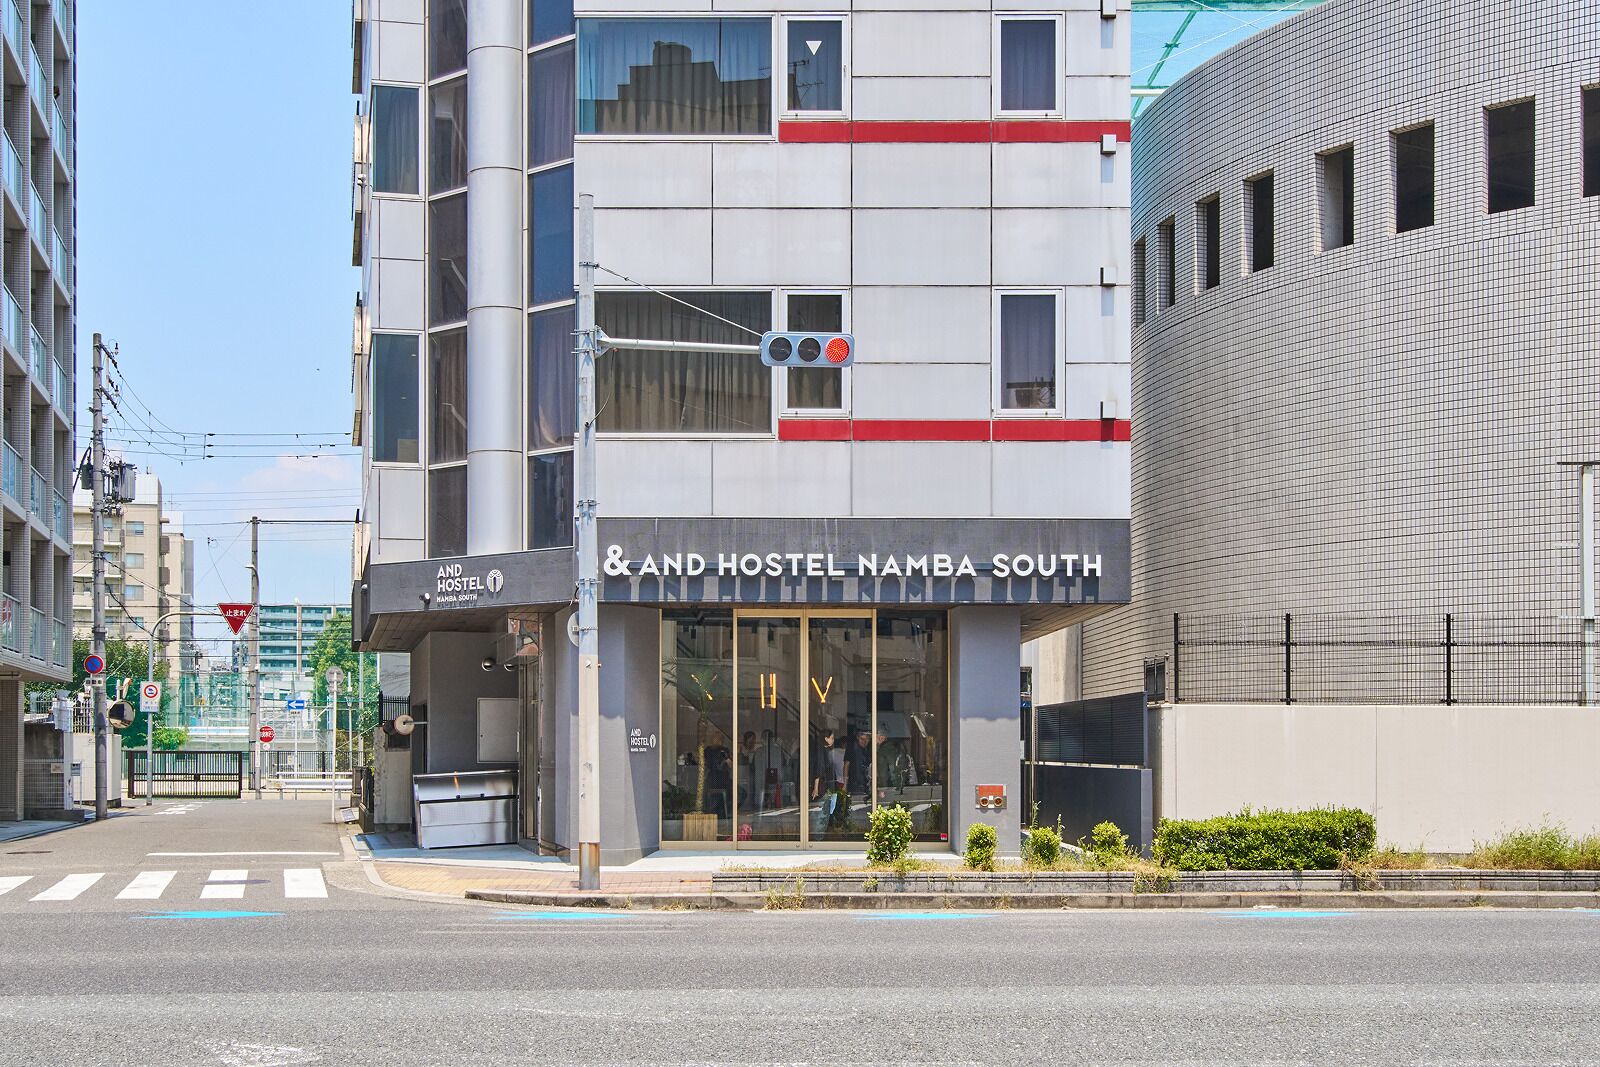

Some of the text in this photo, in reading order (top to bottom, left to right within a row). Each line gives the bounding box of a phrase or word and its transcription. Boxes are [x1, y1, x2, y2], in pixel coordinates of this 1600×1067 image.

[437, 564, 463, 578] AND
[718, 553, 846, 577] HOSTEL
[858, 553, 978, 577] NAMBA
[991, 553, 1103, 578] SOUTH
[437, 577, 485, 592] HOSTEL
[459, 594, 478, 602] SOUTH
[631, 728, 641, 737] AND
[630, 737, 649, 746] HOSTEL
